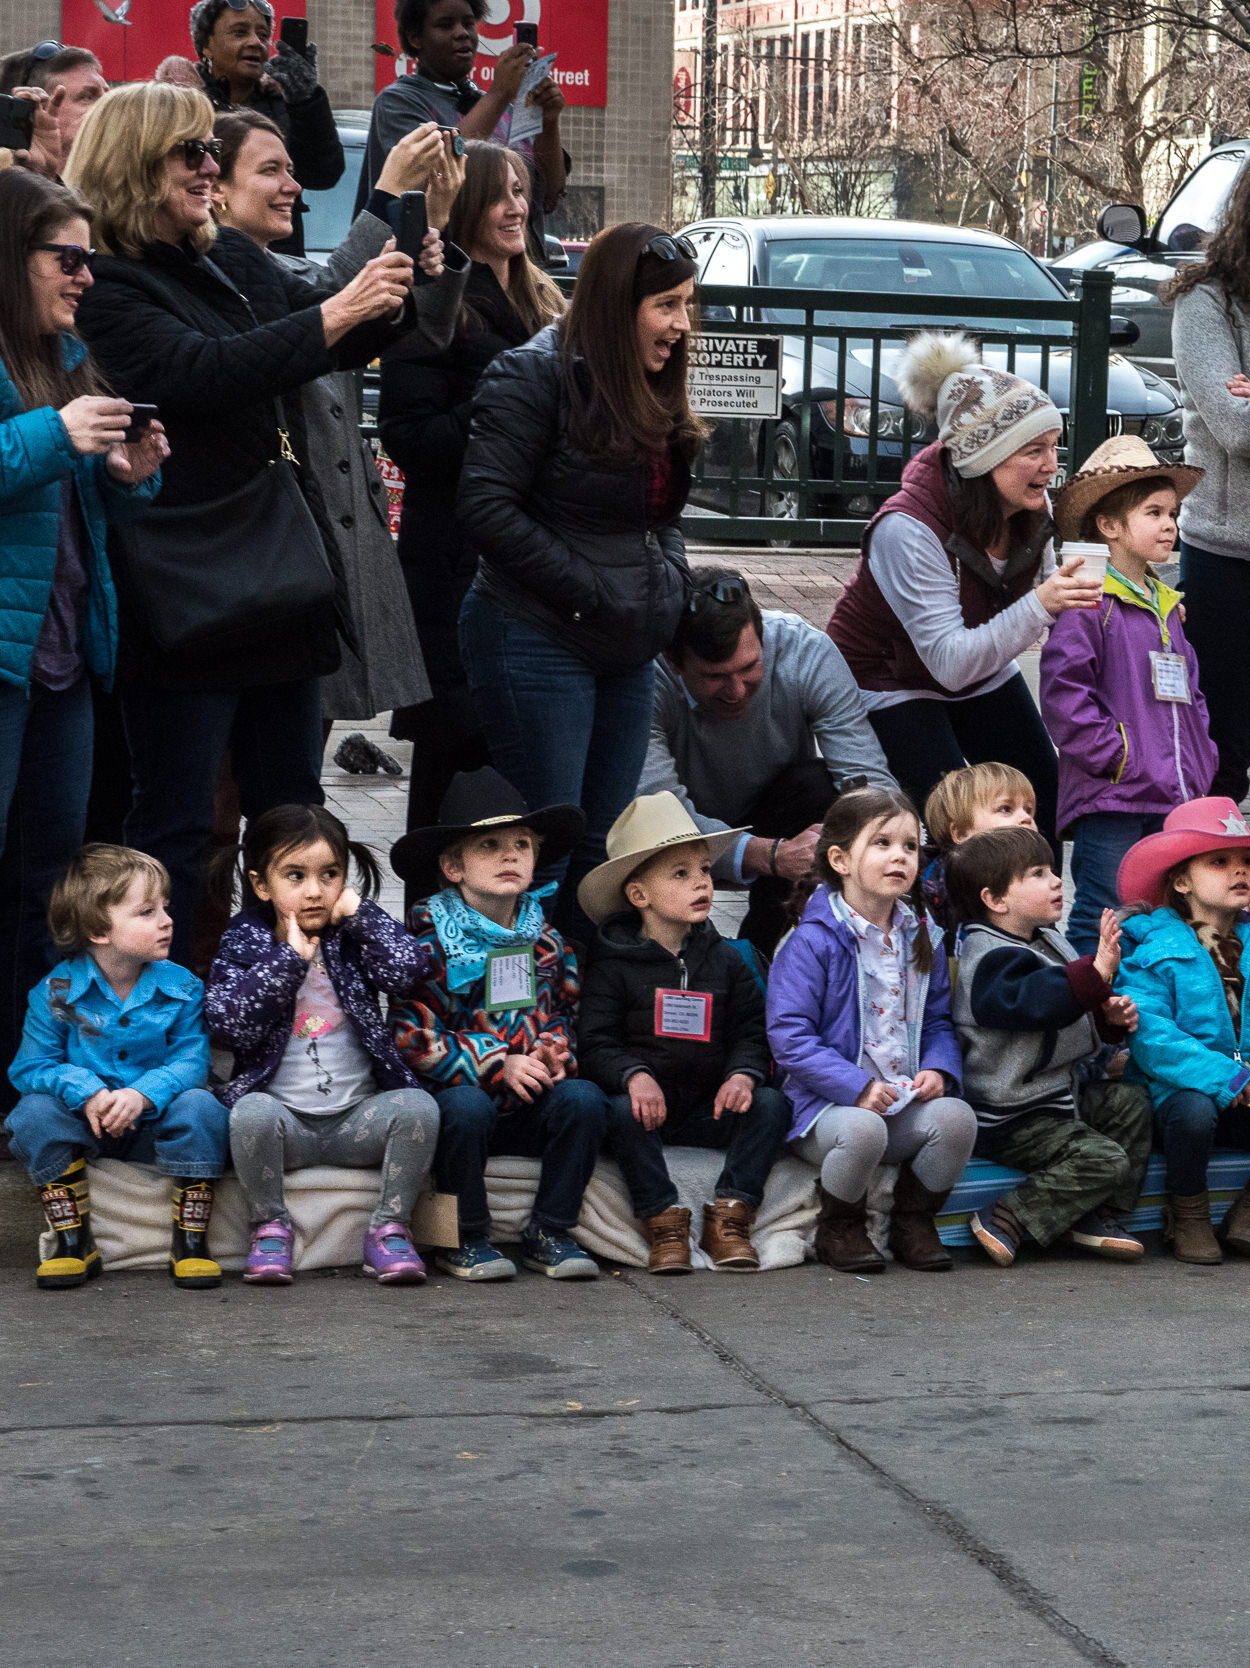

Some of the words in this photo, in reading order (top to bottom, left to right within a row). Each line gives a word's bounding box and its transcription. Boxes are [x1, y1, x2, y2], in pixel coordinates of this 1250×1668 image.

[688, 338, 758, 353] PRIVATE
[688, 352, 767, 367] ROPERTY
[699, 372, 761, 384] Trespassing
[687, 386, 732, 398] Violators
[736, 388, 755, 398] Will
[700, 398, 758, 408] Prosecuted
